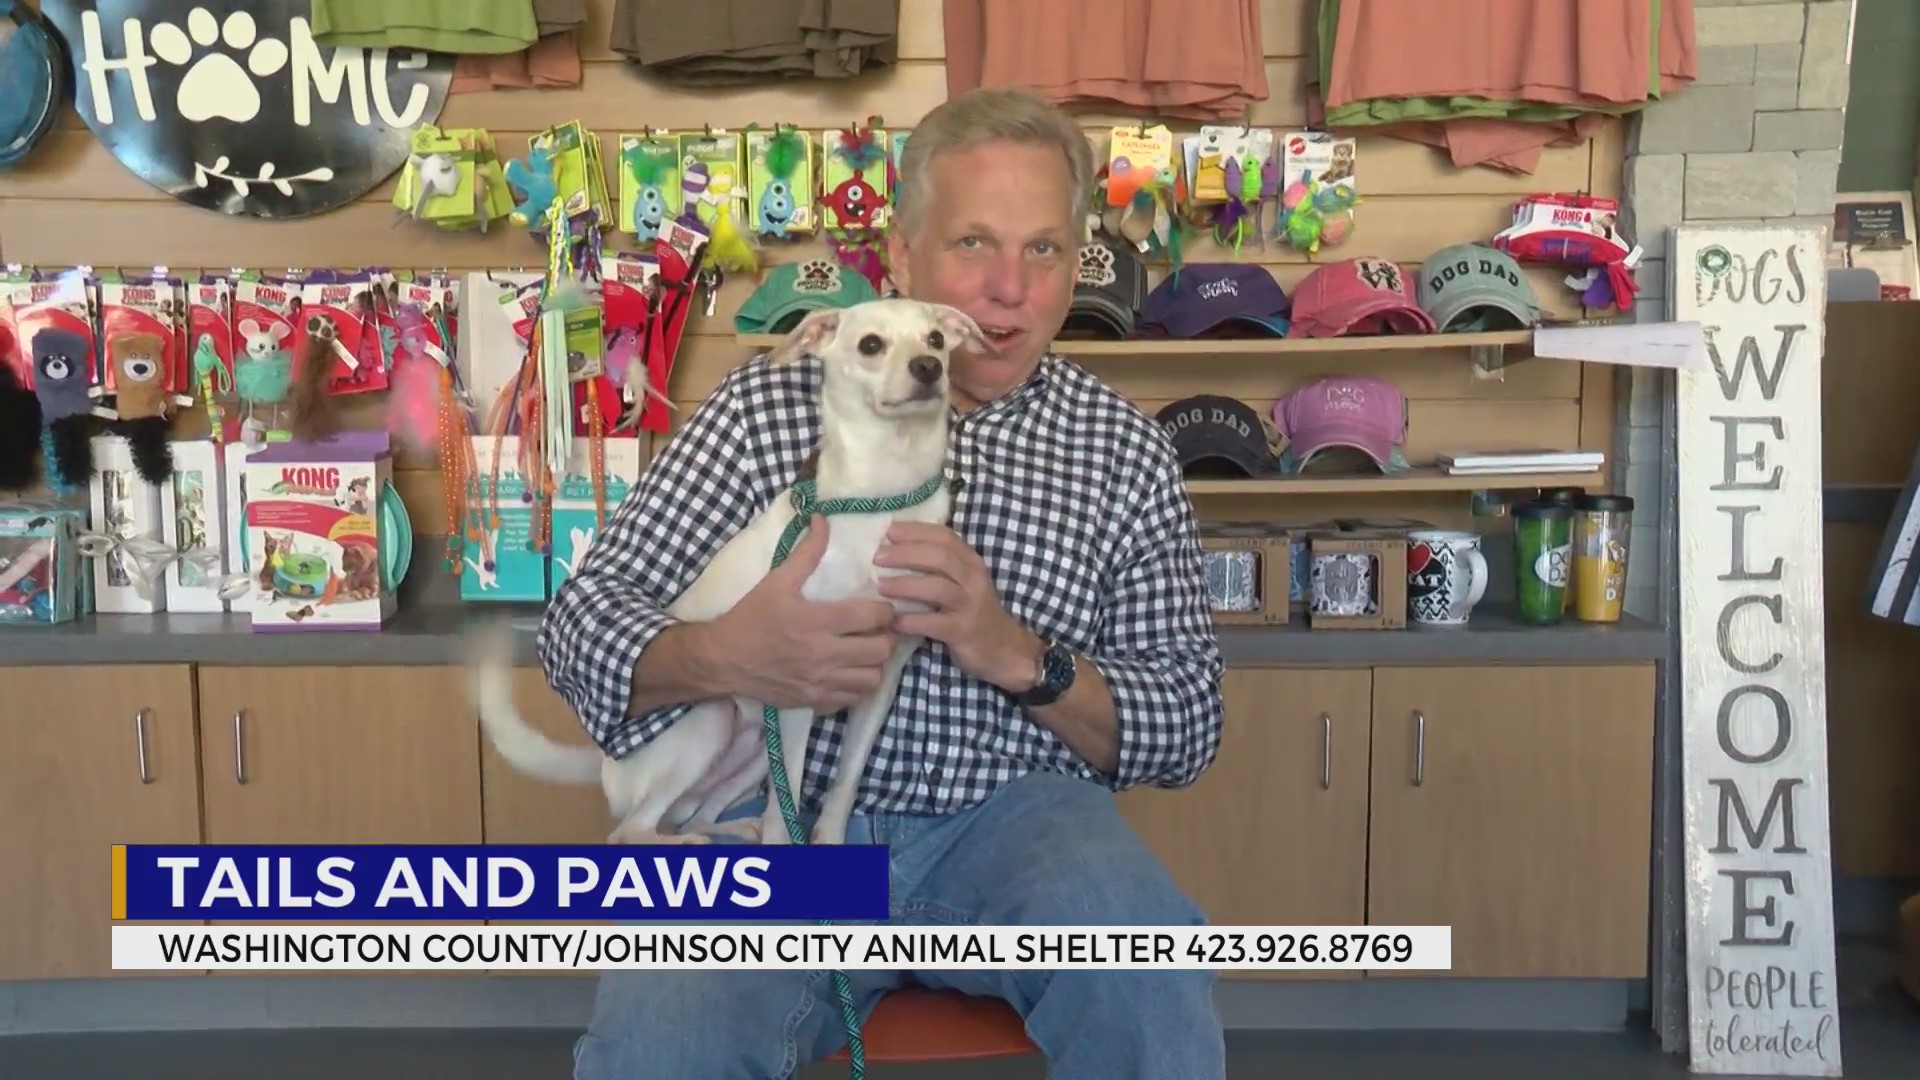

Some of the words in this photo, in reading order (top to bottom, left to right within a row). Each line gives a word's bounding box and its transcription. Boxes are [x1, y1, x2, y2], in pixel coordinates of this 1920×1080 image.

[1552, 209, 1583, 222] KONG
[1430, 260, 1470, 294] DOG
[1478, 259, 1519, 287] DAD
[122, 287, 156, 301] KONG
[255, 286, 287, 303] KONG
[1166, 408, 1203, 439] DOG
[1211, 408, 1250, 438] DAD
[282, 468, 339, 490] KONG
[1702, 324, 1807, 946] WELCOME
[1705, 965, 1826, 1010] PEOPLE
[1706, 1014, 1833, 1059] tolerated
